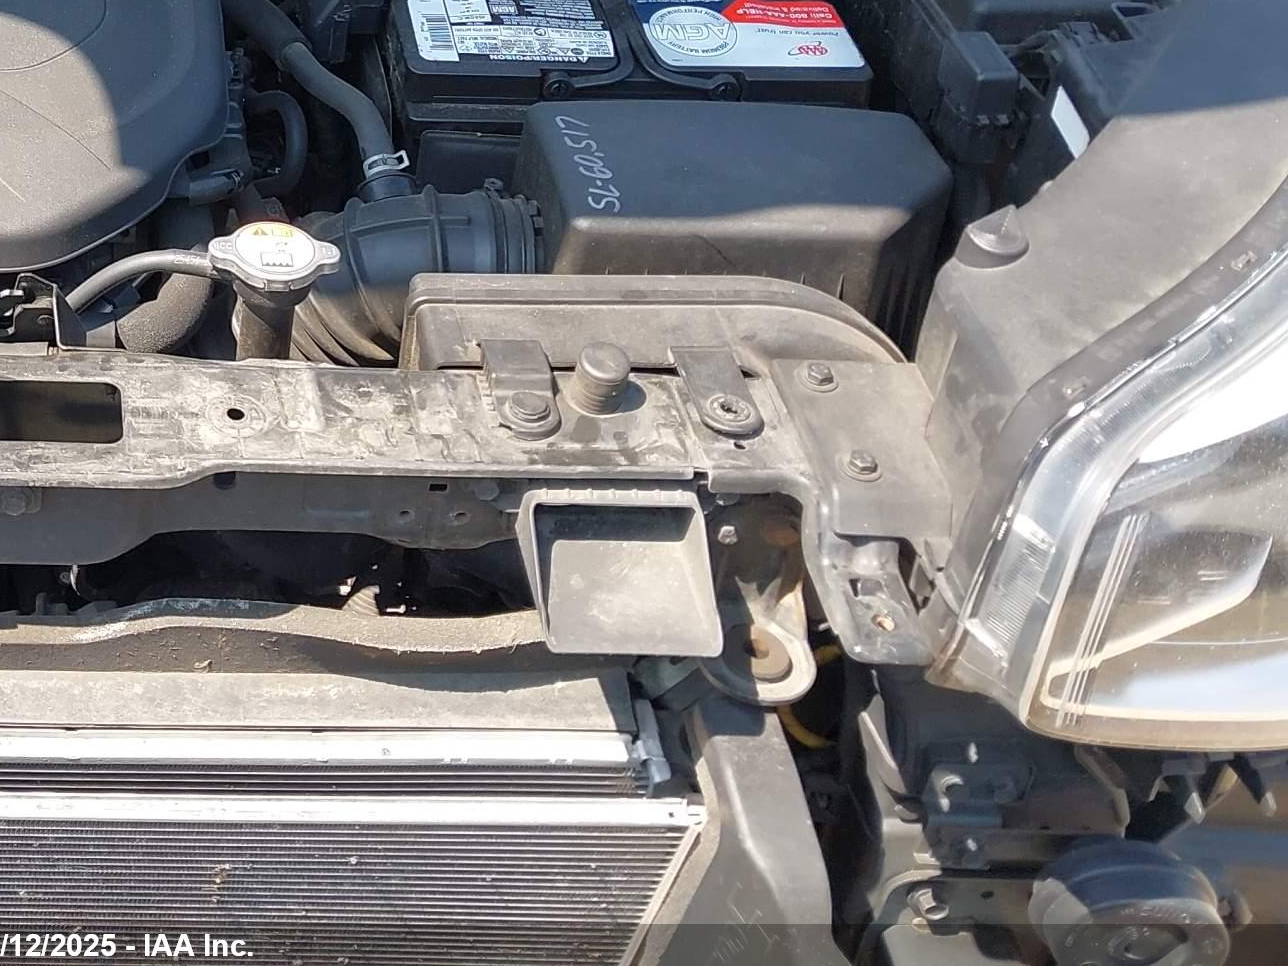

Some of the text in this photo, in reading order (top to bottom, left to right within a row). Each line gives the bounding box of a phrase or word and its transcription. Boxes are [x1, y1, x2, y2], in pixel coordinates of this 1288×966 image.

[654, 8, 703, 23] PERFORMANCE
[736, 8, 808, 19] 800-AAA-HELP
[652, 23, 731, 41] AGM
[667, 41, 729, 54] PREMIUM BATTERY
[798, 45, 825, 56] AAA
